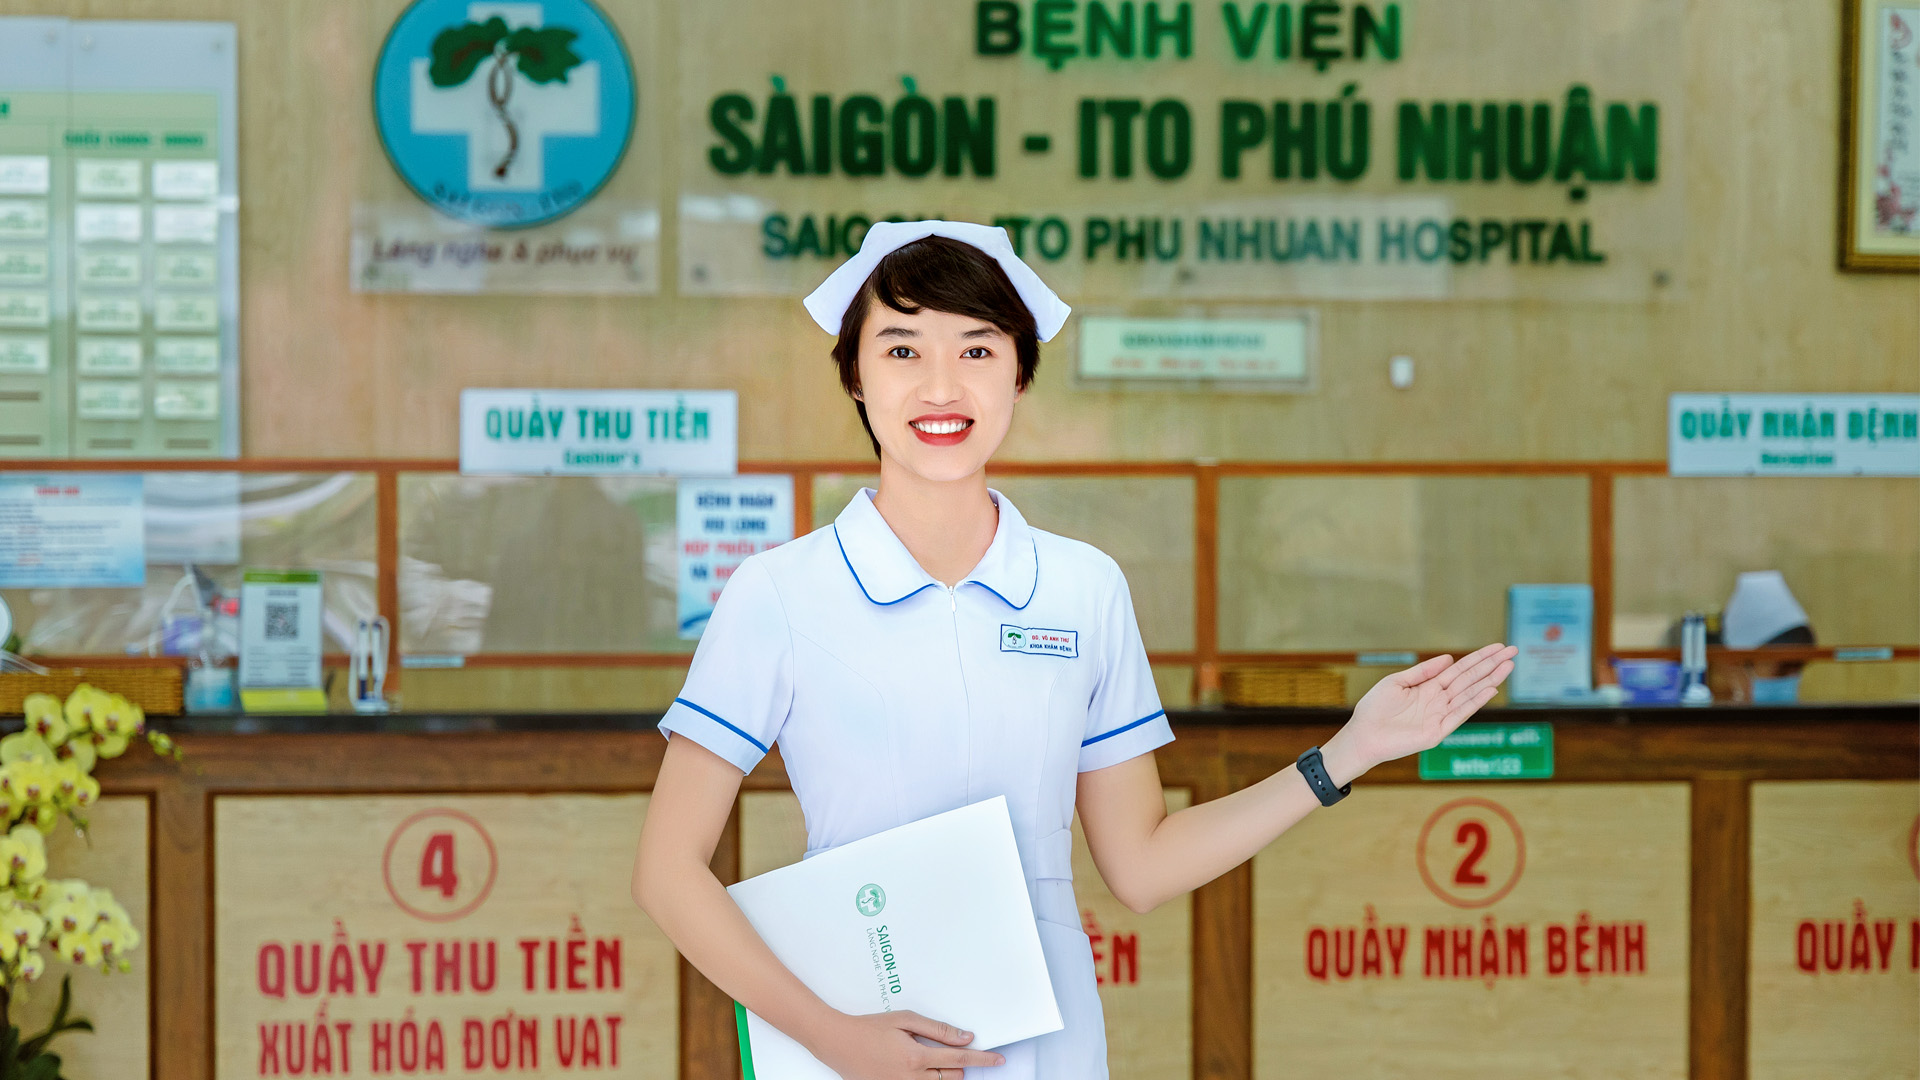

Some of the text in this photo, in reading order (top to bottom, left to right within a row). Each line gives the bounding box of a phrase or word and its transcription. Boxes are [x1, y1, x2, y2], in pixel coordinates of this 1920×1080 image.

[976, 0, 1401, 73] BỆNH VIỆN
[709, 75, 1658, 200] SÀIGÒN - ITO PHÚ NHUẬN
[994, 215, 1070, 260] TO
[1086, 217, 1182, 261] PHU
[1201, 221, 1361, 262] NHUAN
[1379, 221, 1606, 264] HOSPITAL
[578, 408, 633, 440] THU
[420, 833, 459, 899] 4
[1453, 820, 1489, 885] 2
[257, 912, 624, 998] QUẦY THU TIỀN
[876, 925, 902, 994] SAIGON-ITO
[1306, 904, 1646, 990] QUẦY NHẬN BỆNH
[1797, 898, 1896, 974] QUẦY
[259, 1000, 623, 1075] XUẤT HÓA ĐƠN VAT
